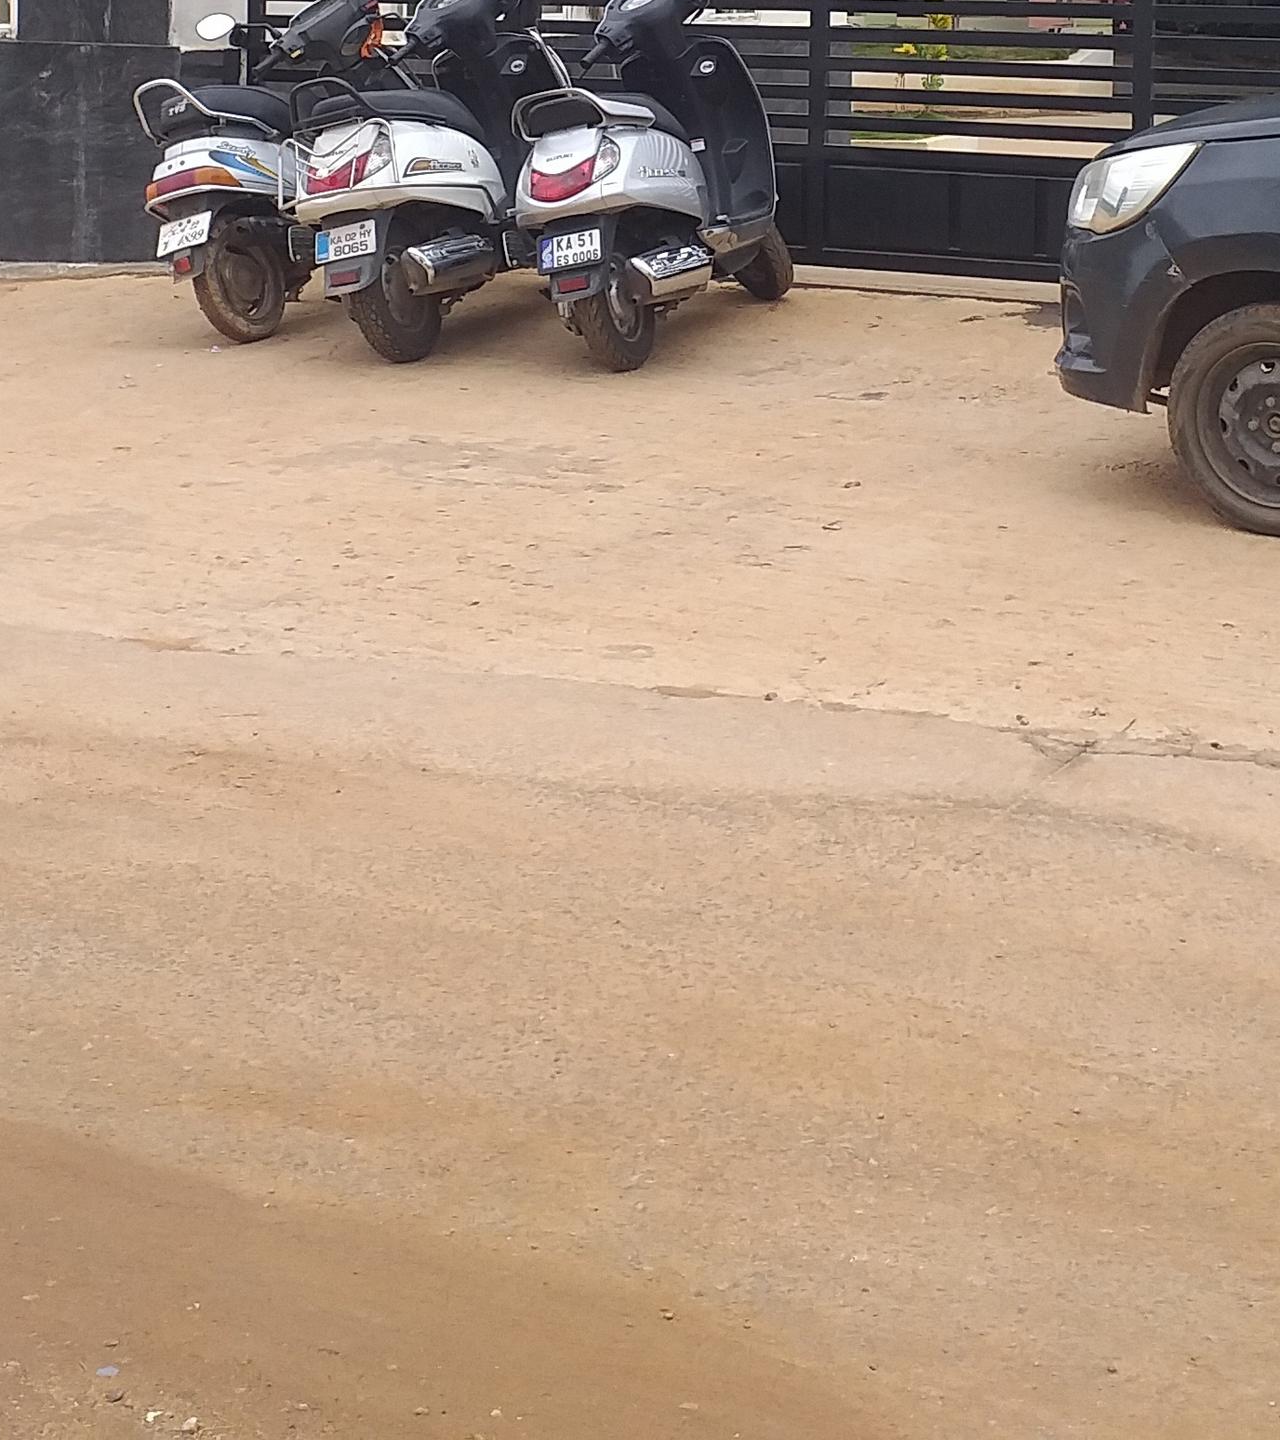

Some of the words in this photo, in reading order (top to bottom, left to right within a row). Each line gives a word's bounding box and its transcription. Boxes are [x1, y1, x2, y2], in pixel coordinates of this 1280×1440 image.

[330, 236, 343, 245] KA
[345, 232, 357, 243] 02
[359, 229, 372, 240] HY
[556, 238, 573, 252] KA
[577, 231, 594, 248] 51
[333, 239, 369, 257] 8065
[556, 253, 570, 266] ES
[572, 248, 599, 264] 0006
